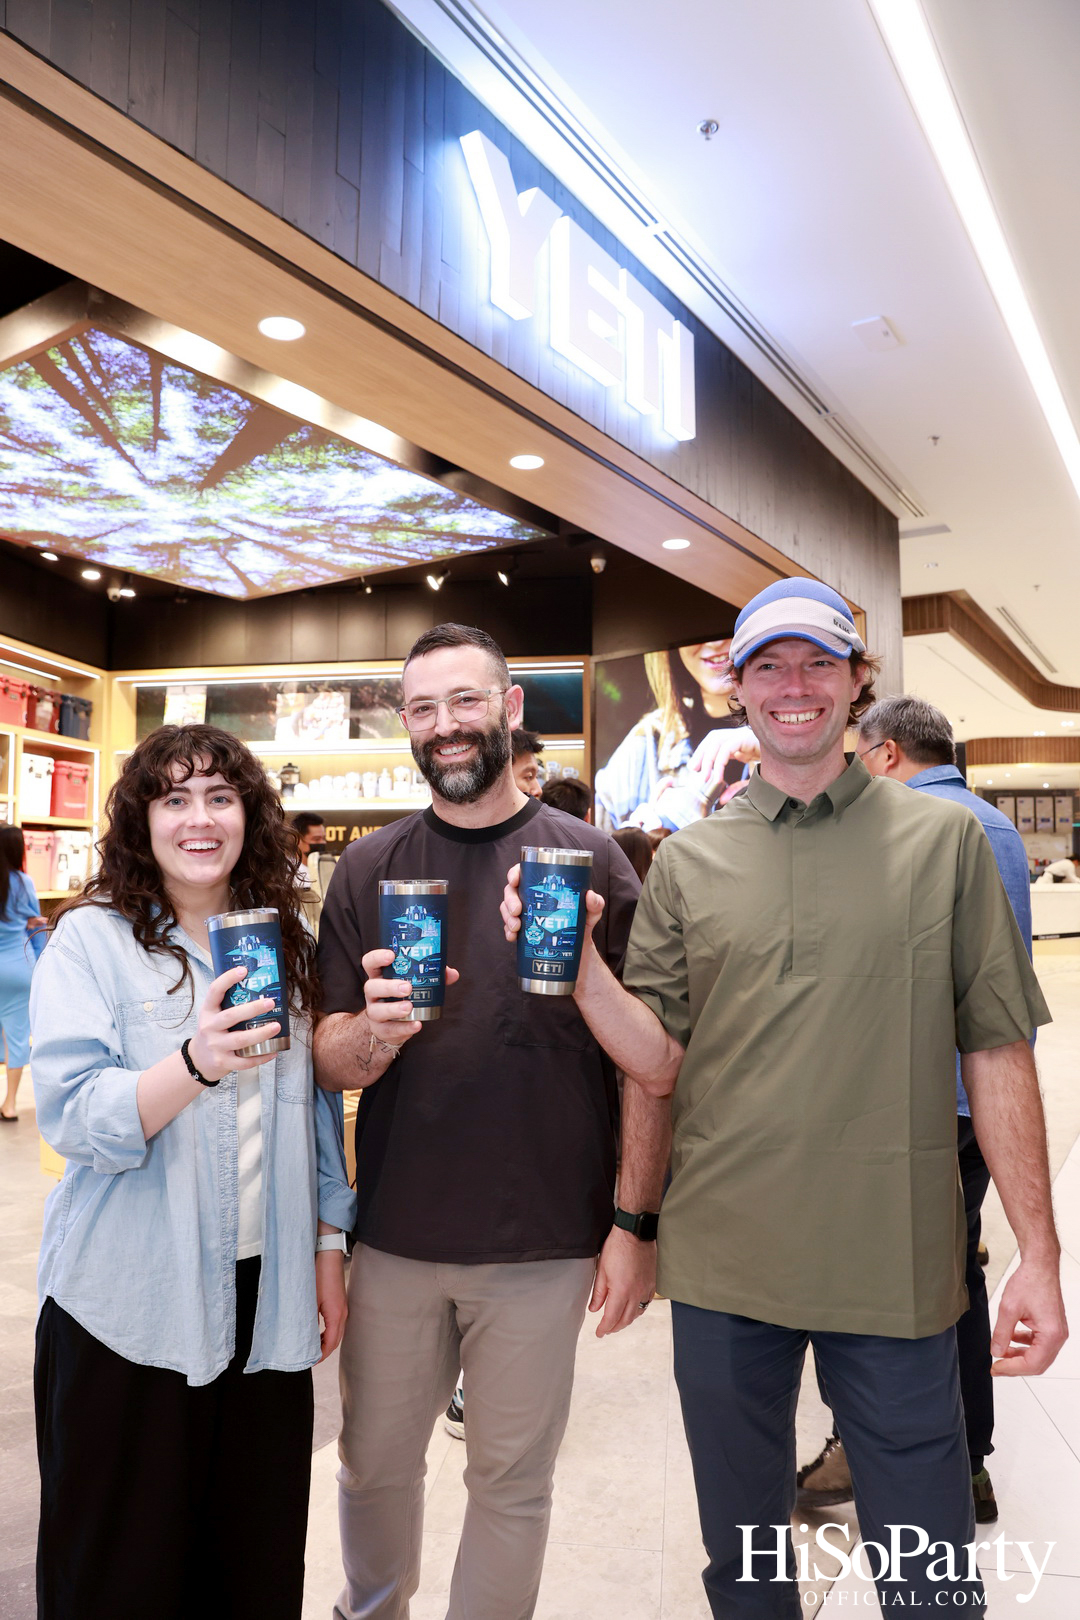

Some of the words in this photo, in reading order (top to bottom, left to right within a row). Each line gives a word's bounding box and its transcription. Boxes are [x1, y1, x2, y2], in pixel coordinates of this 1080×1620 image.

[459, 129, 696, 441] YETI
[325, 825, 347, 841] OT
[349, 825, 383, 841] AN
[534, 916, 569, 929] YETI
[400, 946, 432, 957] YETI
[535, 962, 561, 973] YETI
[239, 975, 271, 988] YETI
